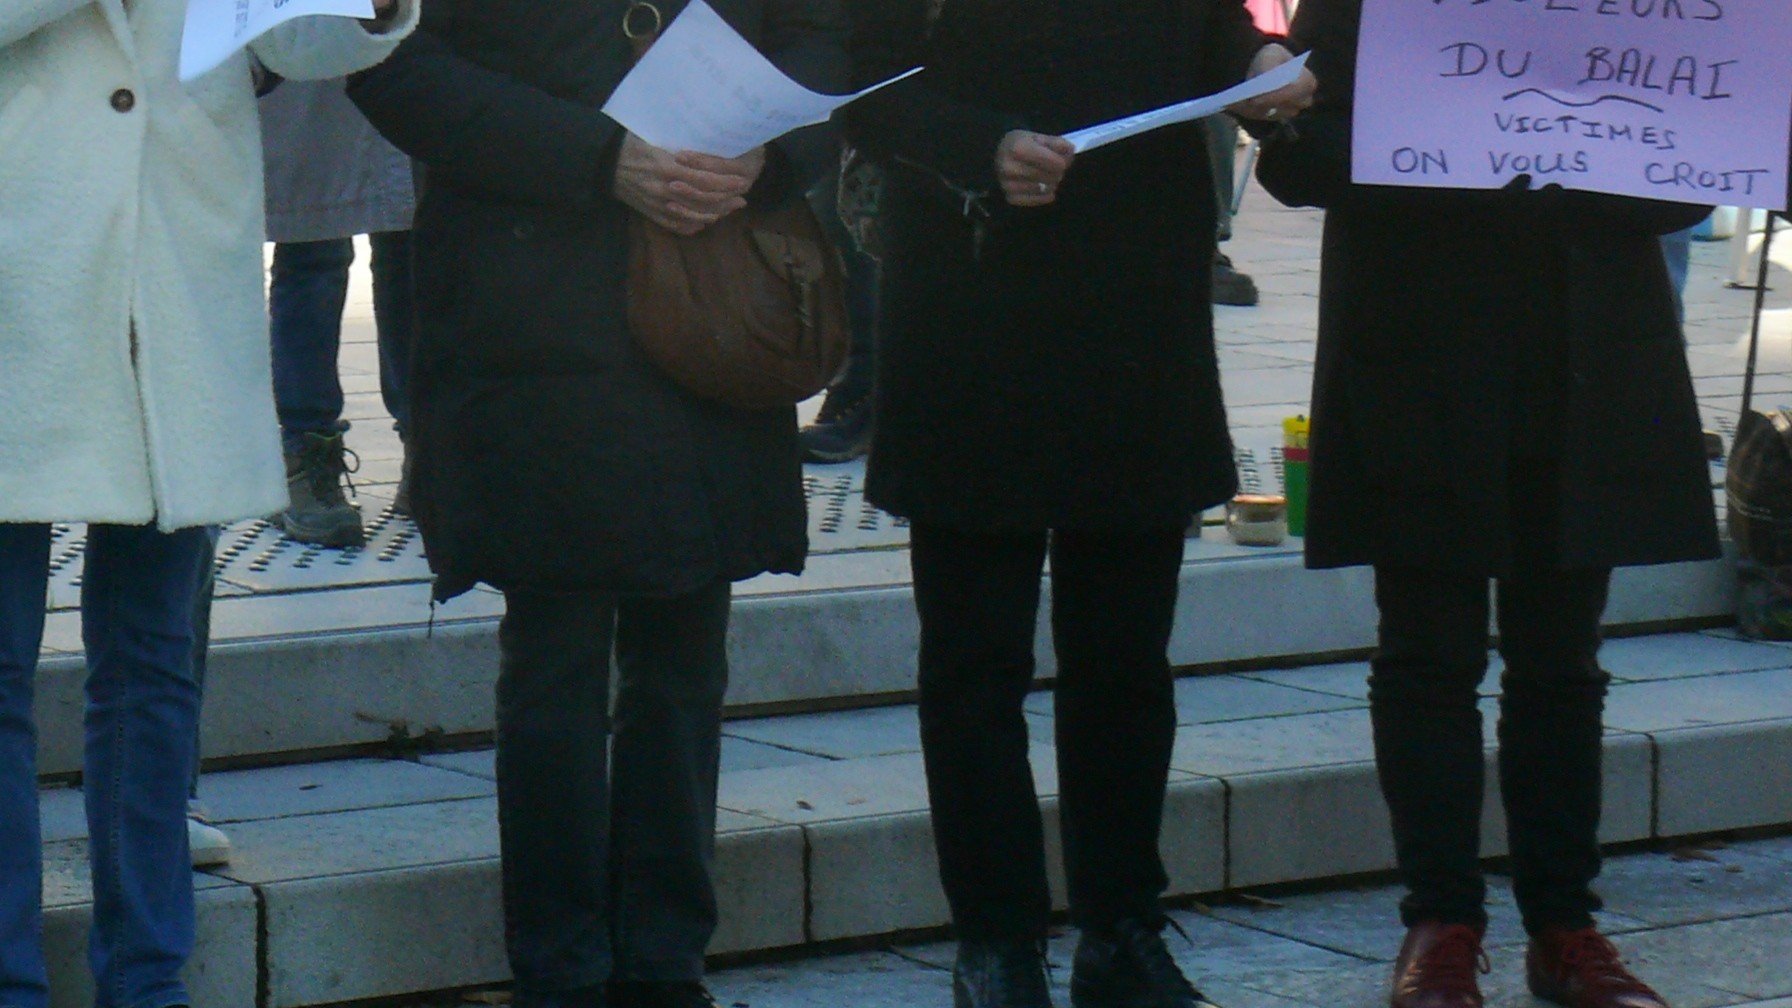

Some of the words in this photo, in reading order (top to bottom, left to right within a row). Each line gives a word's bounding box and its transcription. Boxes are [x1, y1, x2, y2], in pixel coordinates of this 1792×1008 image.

[1439, 42, 1532, 78] DU
[1577, 46, 1739, 100] BALAI
[1493, 112, 1678, 150] VICTIMES
[1391, 147, 1449, 174] ON
[1488, 150, 1589, 175] VOUS
[1644, 162, 1770, 195] CROIT
